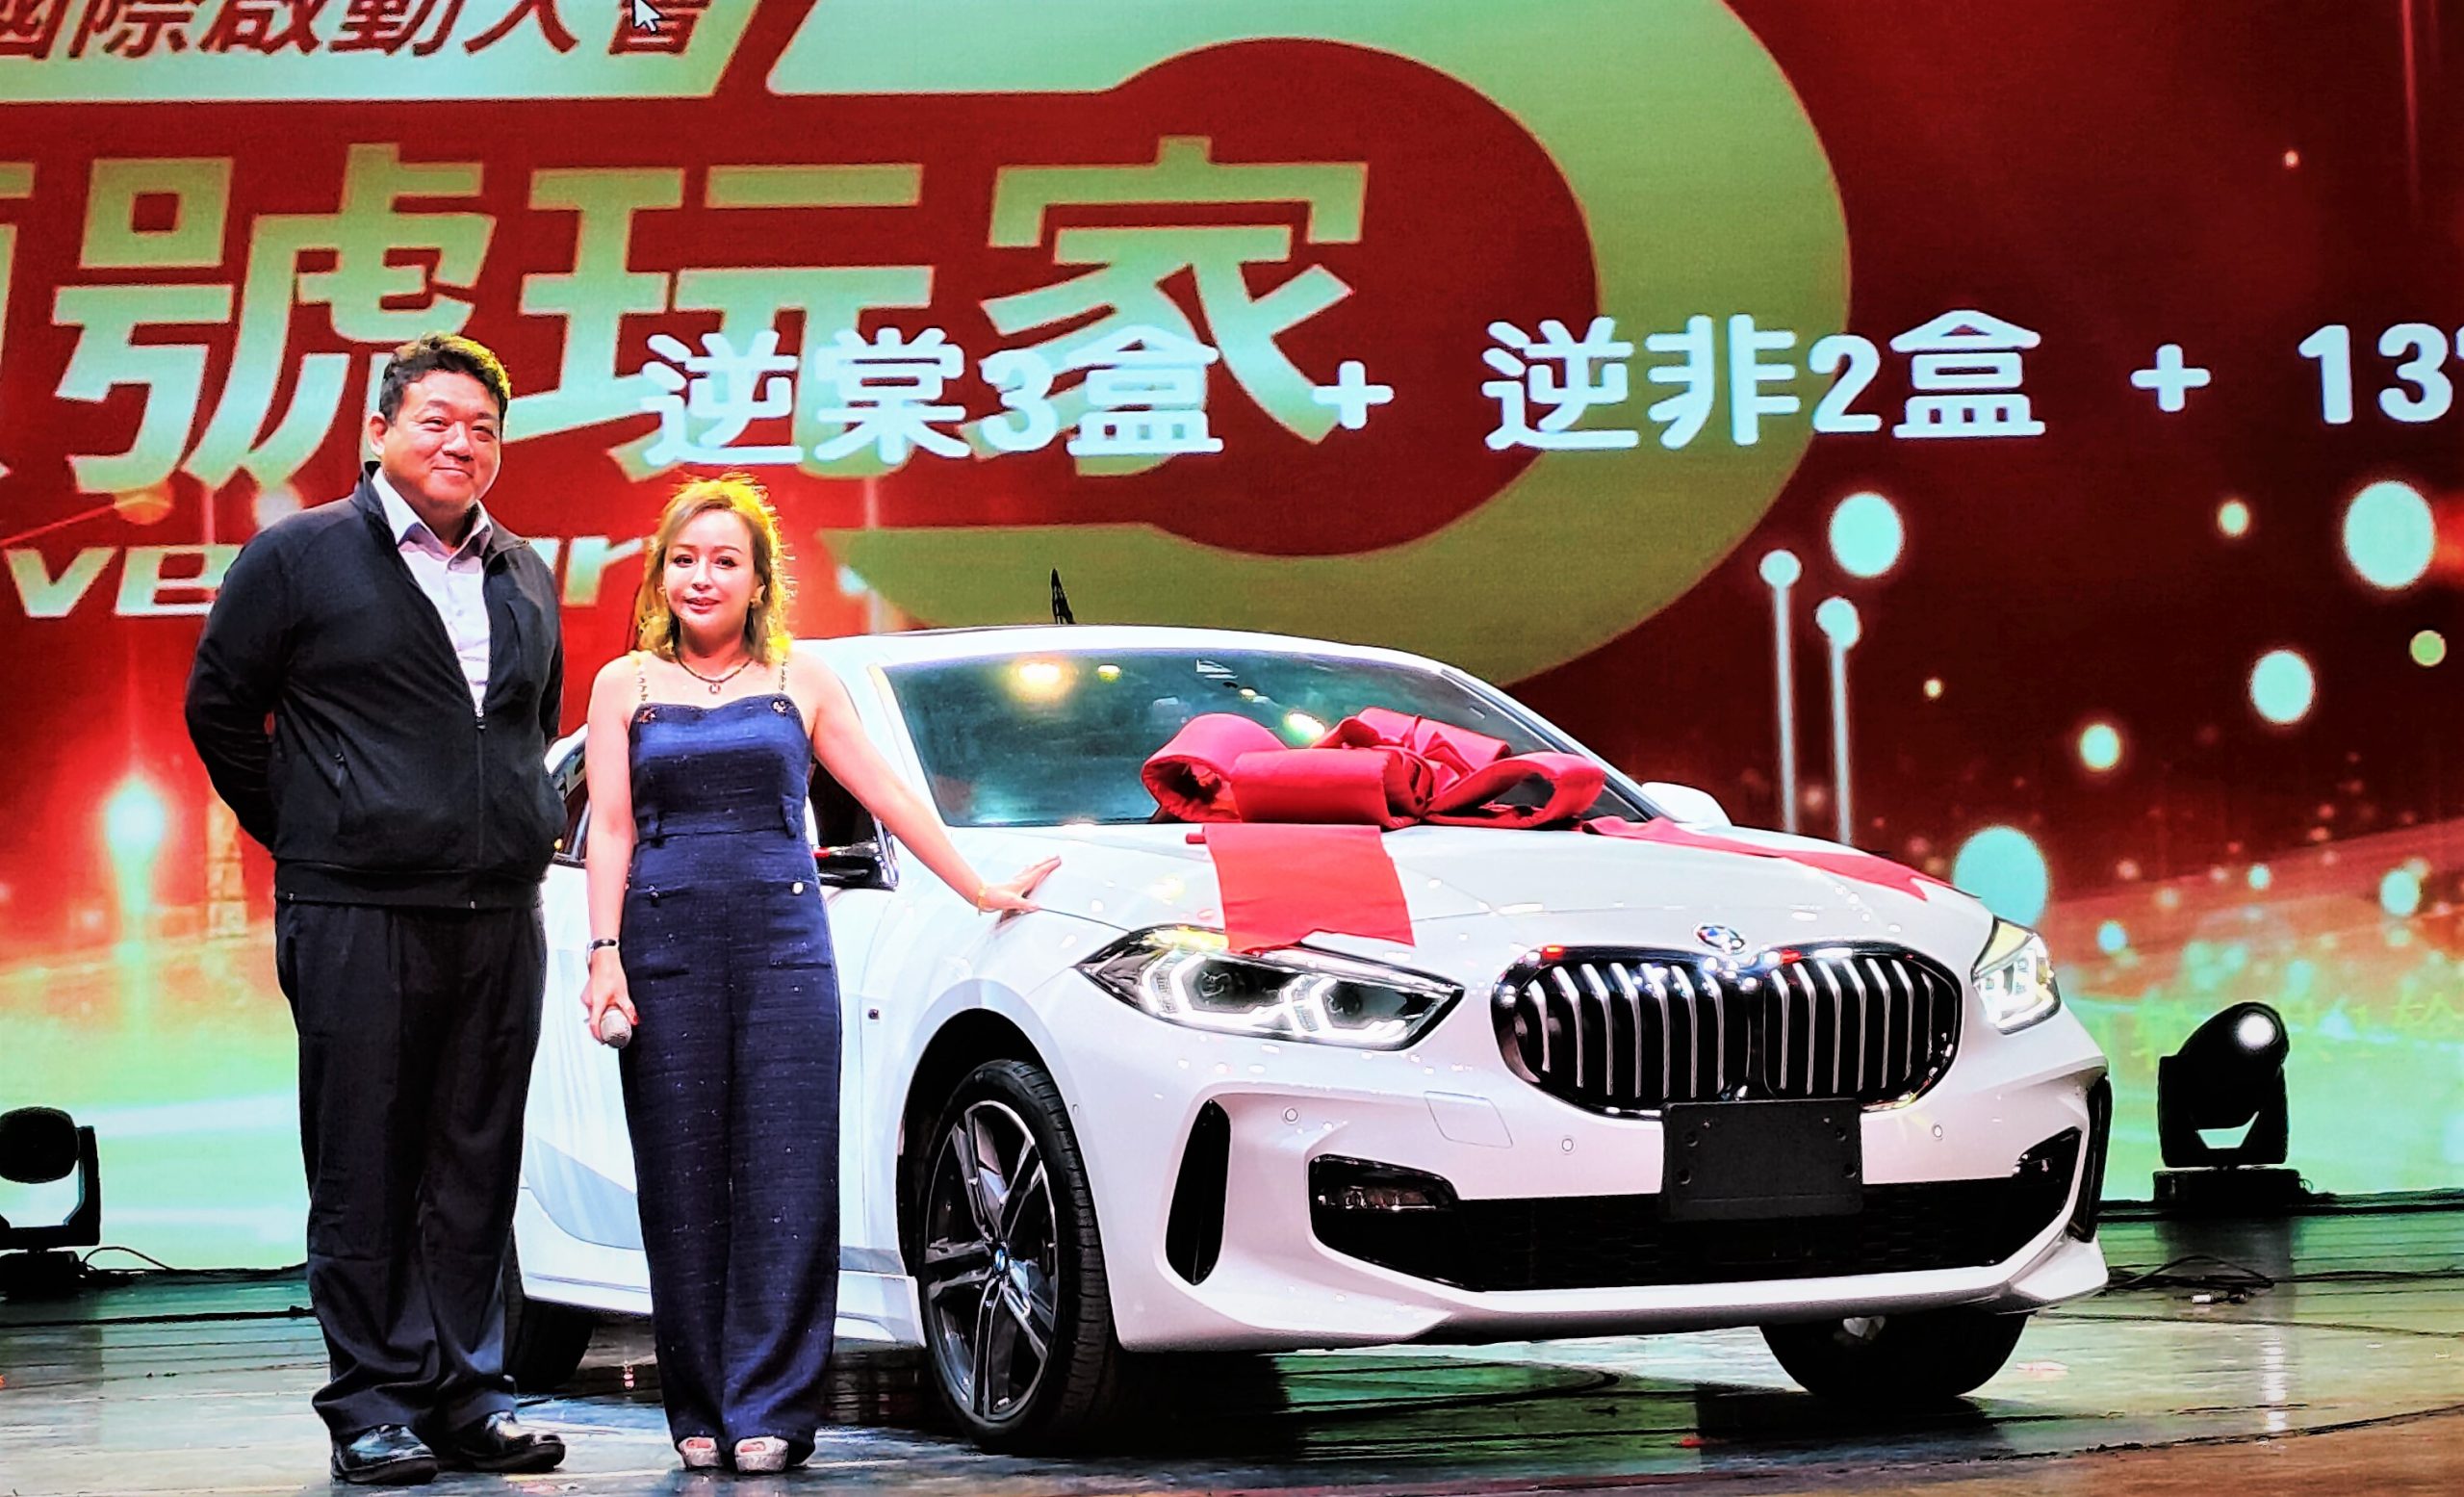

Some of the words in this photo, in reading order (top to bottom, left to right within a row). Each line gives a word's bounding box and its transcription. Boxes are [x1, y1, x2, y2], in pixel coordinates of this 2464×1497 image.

[0, 136, 1368, 498] 號玩家
[642, 325, 1223, 466] 逆棠3盒
[1482, 310, 2045, 450] 逆非2盒
[2298, 323, 2464, 424] 13
